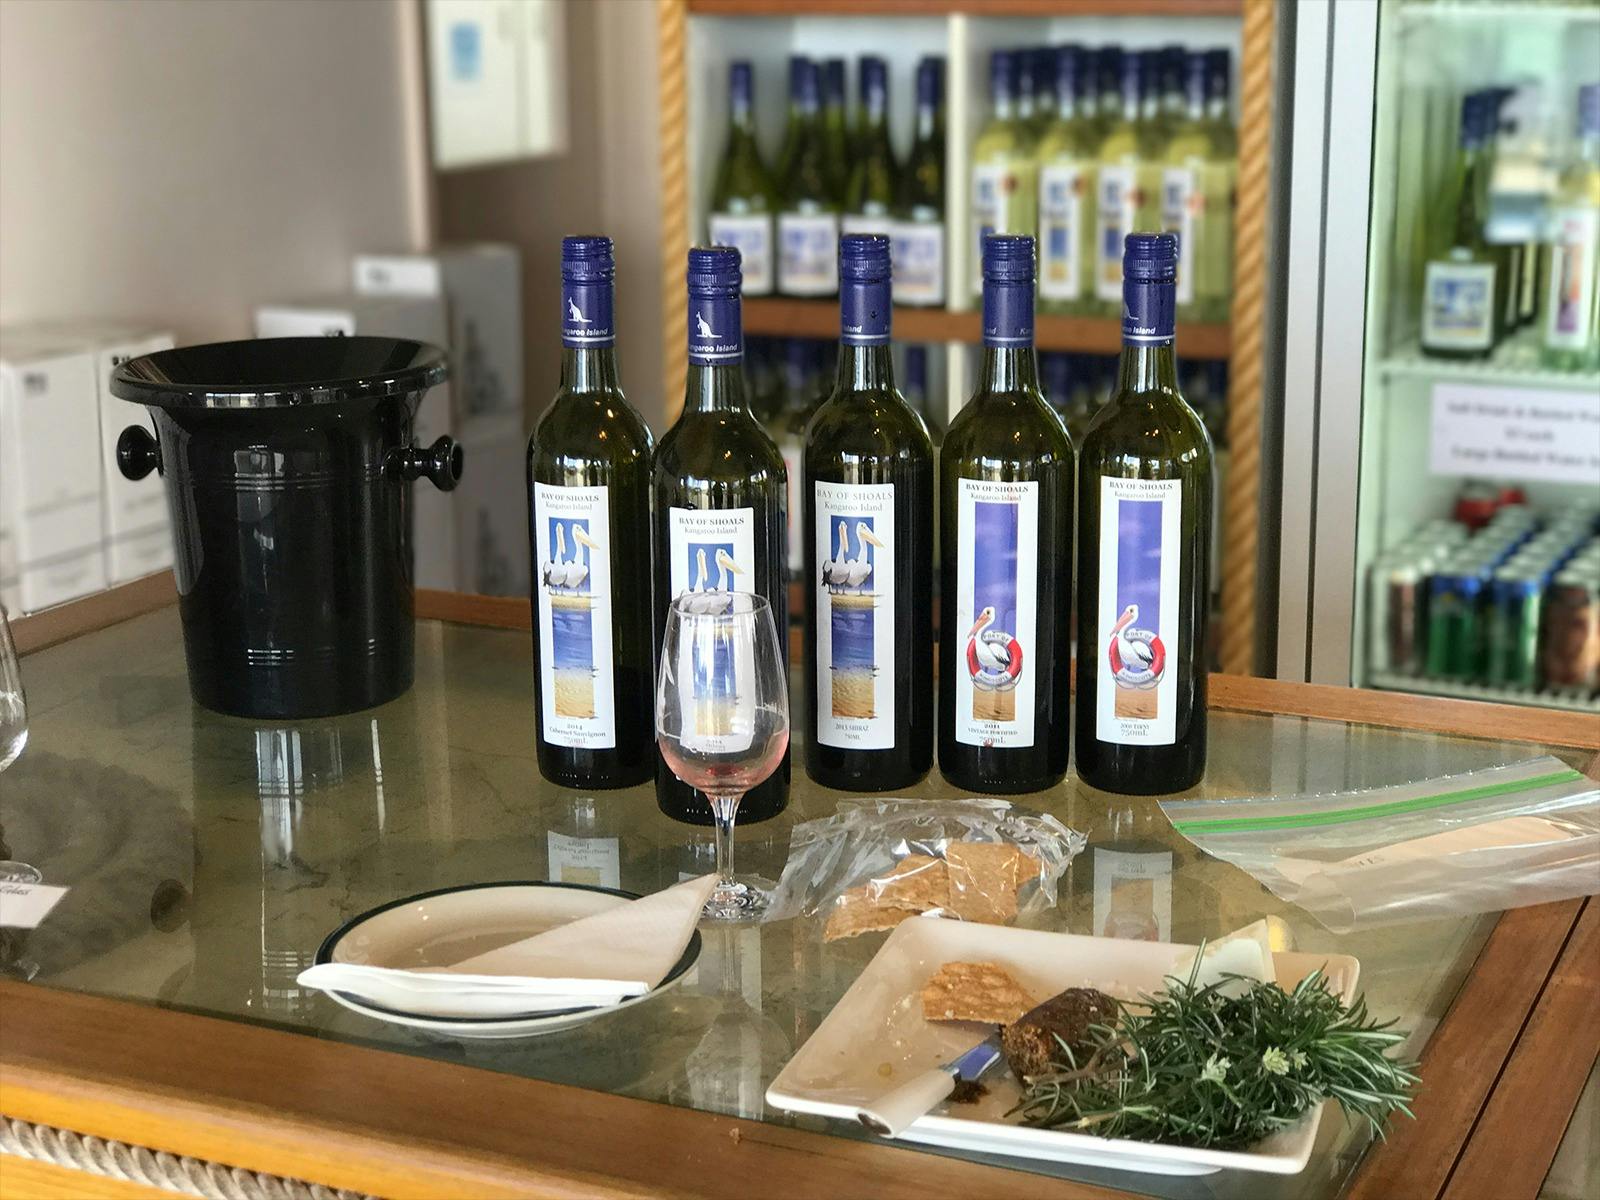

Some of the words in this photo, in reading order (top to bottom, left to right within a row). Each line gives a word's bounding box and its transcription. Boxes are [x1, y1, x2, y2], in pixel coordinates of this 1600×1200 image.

[586, 328, 608, 336] Island
[1133, 326, 1156, 335] Island
[716, 343, 738, 352] Island
[966, 483, 980, 491] BAY
[1109, 481, 1124, 489] BAY
[541, 492, 555, 500] BAY
[566, 494, 599, 502] SHOALS
[817, 489, 832, 498] BAY
[836, 492, 848, 500] OF
[853, 492, 893, 501] SHOALS
[971, 492, 1000, 501] Kangaroo
[1001, 494, 1022, 502] Island
[1114, 490, 1144, 499] Kangaroo
[1146, 491, 1166, 499] Island
[573, 503, 593, 511] Island
[824, 501, 858, 512] Kangaroo
[860, 503, 883, 512] Island
[679, 517, 694, 525] BAY
[696, 517, 707, 526] OF
[709, 517, 745, 526] SHOALS
[684, 526, 715, 536] Kangaroo
[716, 526, 738, 535] Island
[573, 730, 606, 738] Sauvignon
